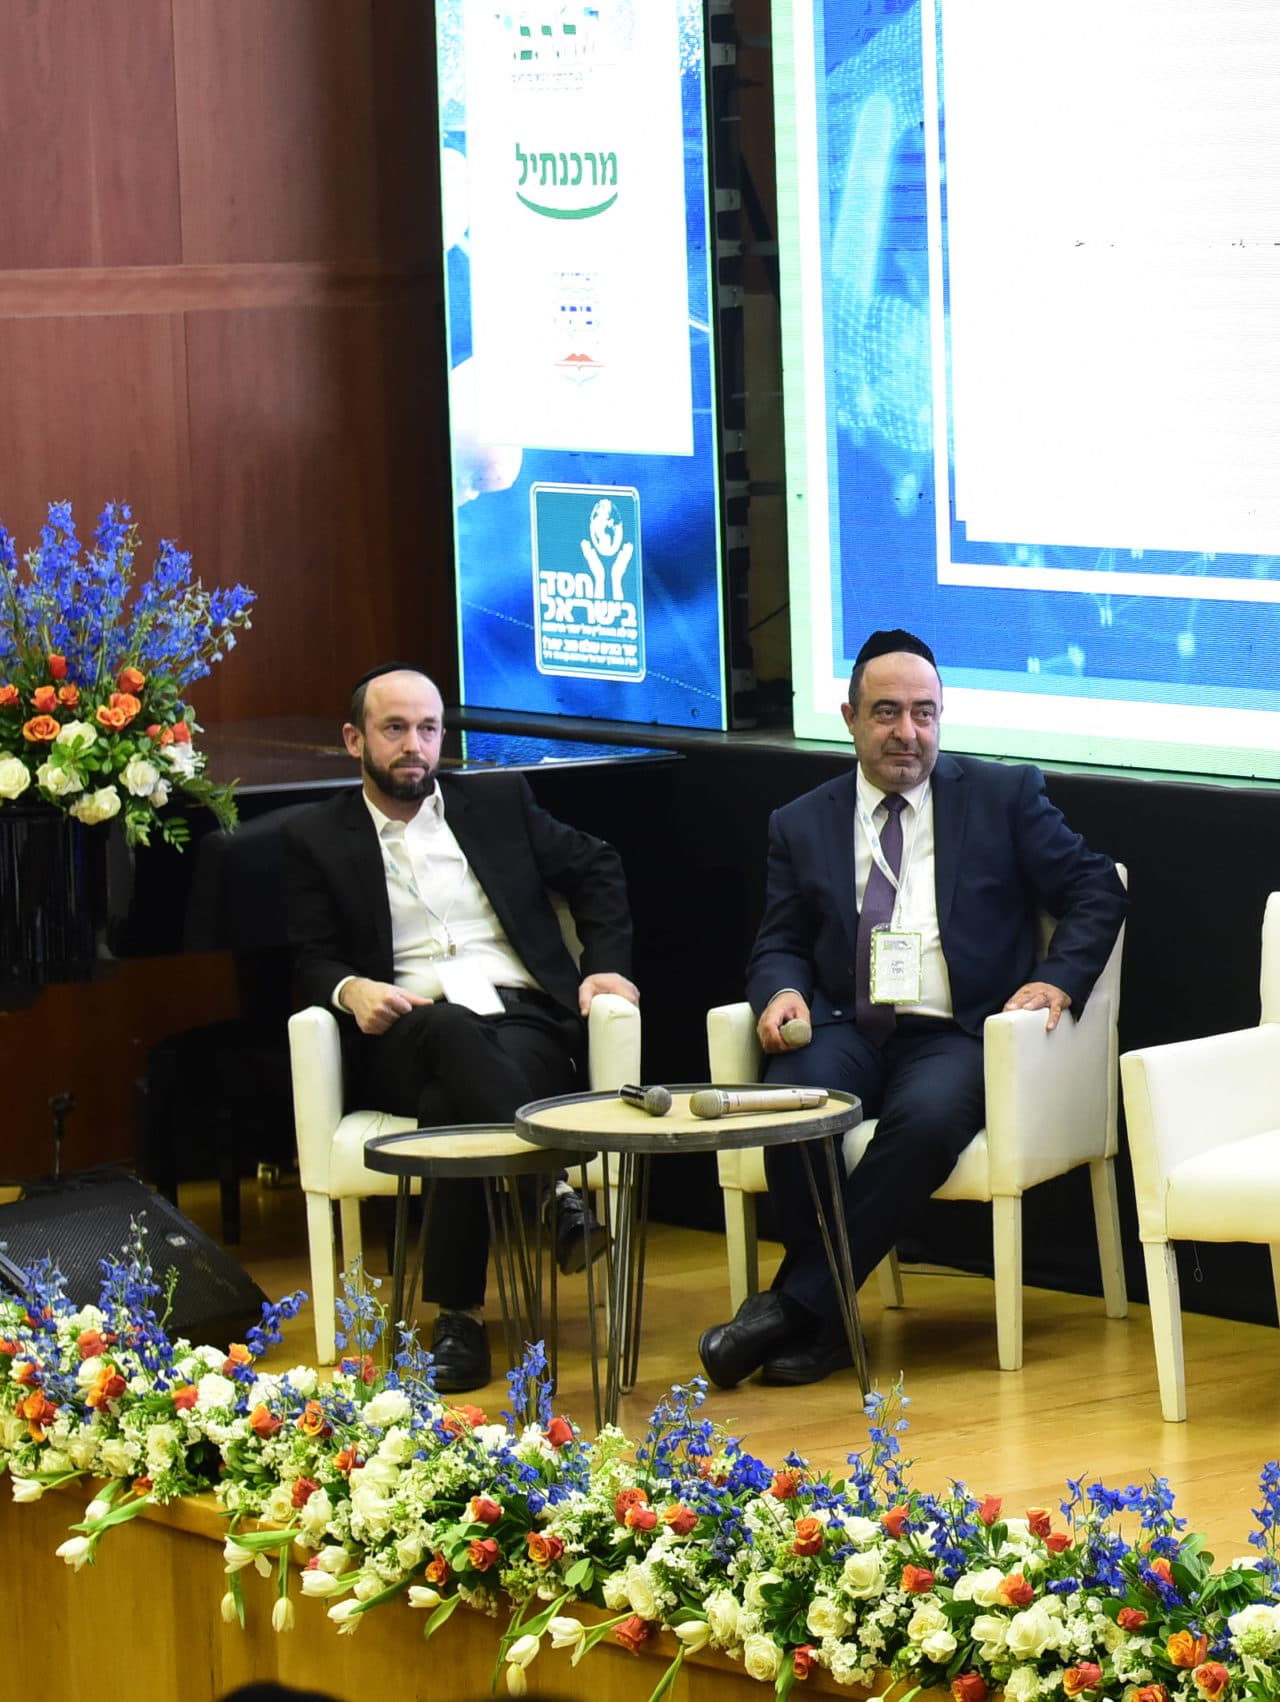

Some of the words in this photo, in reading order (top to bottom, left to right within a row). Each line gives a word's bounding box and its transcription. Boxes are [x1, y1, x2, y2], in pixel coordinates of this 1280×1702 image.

[515, 142, 618, 186] מרכנתיל
[540, 571, 594, 598] חסד
[541, 584, 637, 627] בישראל
